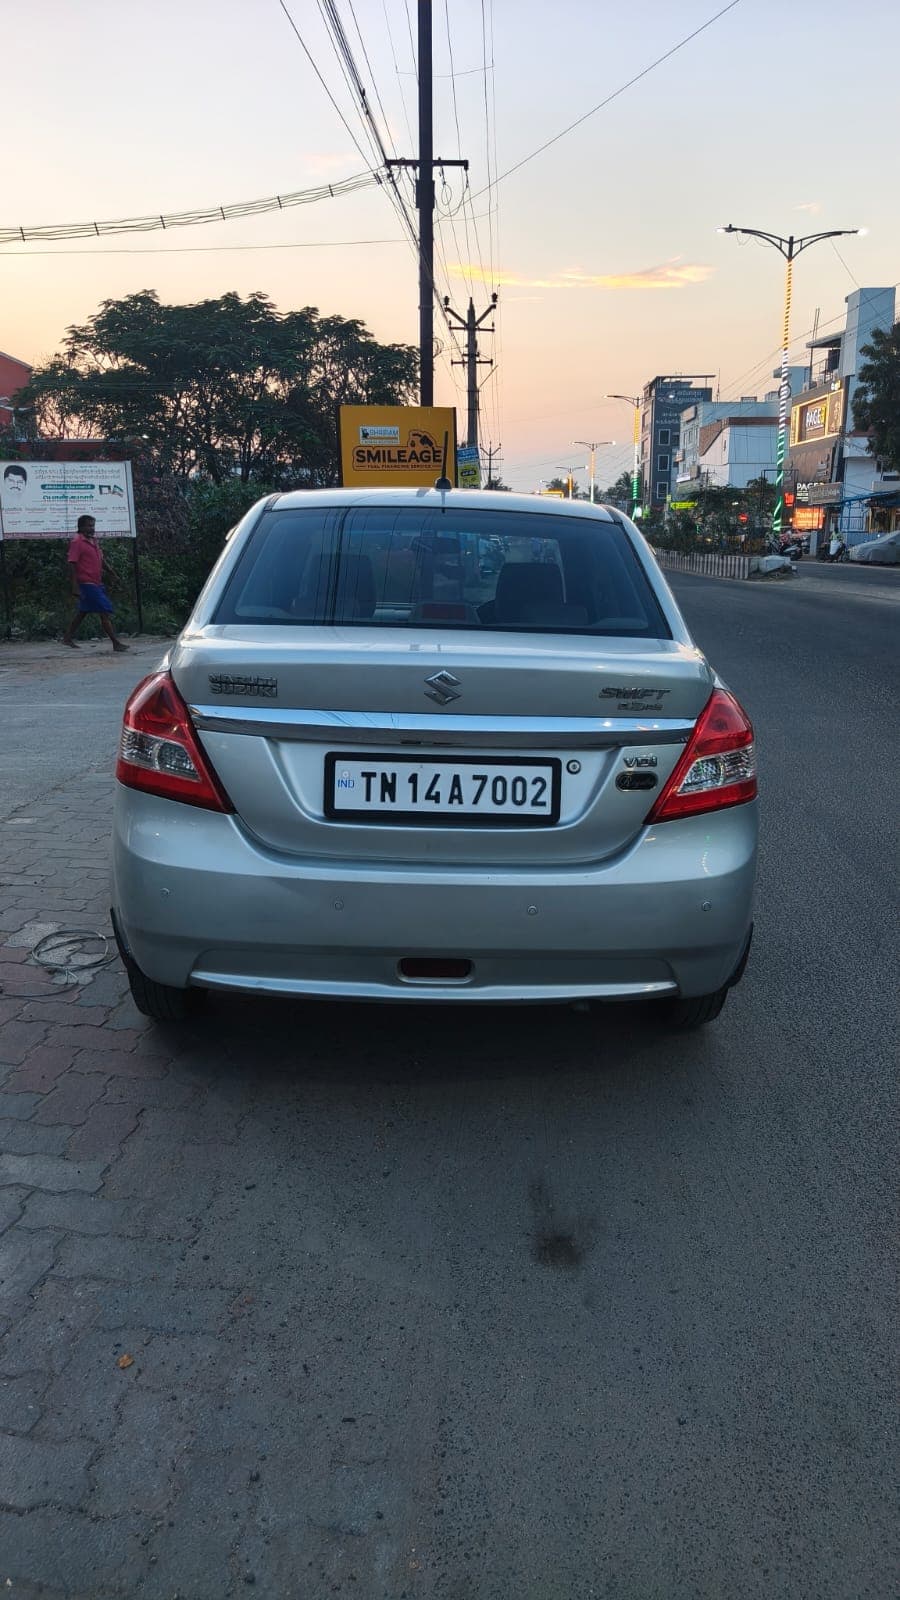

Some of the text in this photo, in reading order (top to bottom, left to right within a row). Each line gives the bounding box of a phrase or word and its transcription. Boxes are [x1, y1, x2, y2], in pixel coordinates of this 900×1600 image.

[355, 449, 442, 463] SMILEAGE
[208, 683, 278, 697] SUZUKI
[598, 687, 672, 699] SWIFT
[337, 778, 355, 789] IND
